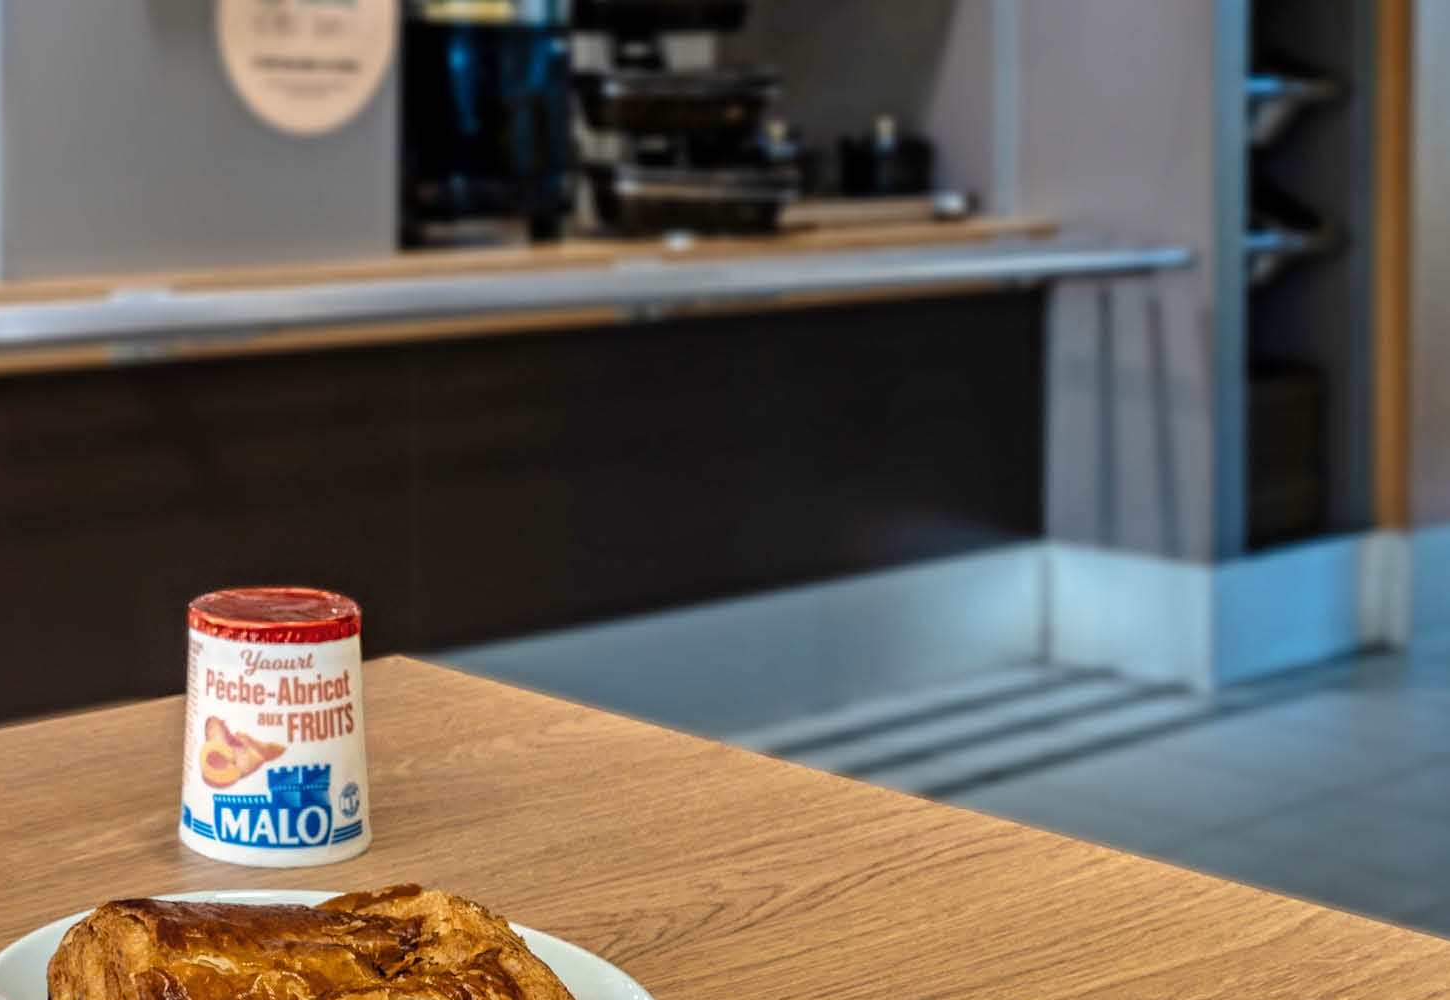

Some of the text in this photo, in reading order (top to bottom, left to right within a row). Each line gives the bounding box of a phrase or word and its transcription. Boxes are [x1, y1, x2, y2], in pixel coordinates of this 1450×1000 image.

[240, 650, 314, 676] Yaourt
[206, 668, 350, 705] Pêche-Abricot
[257, 702, 354, 743] aux FRUITS
[220, 806, 328, 845] MALO
